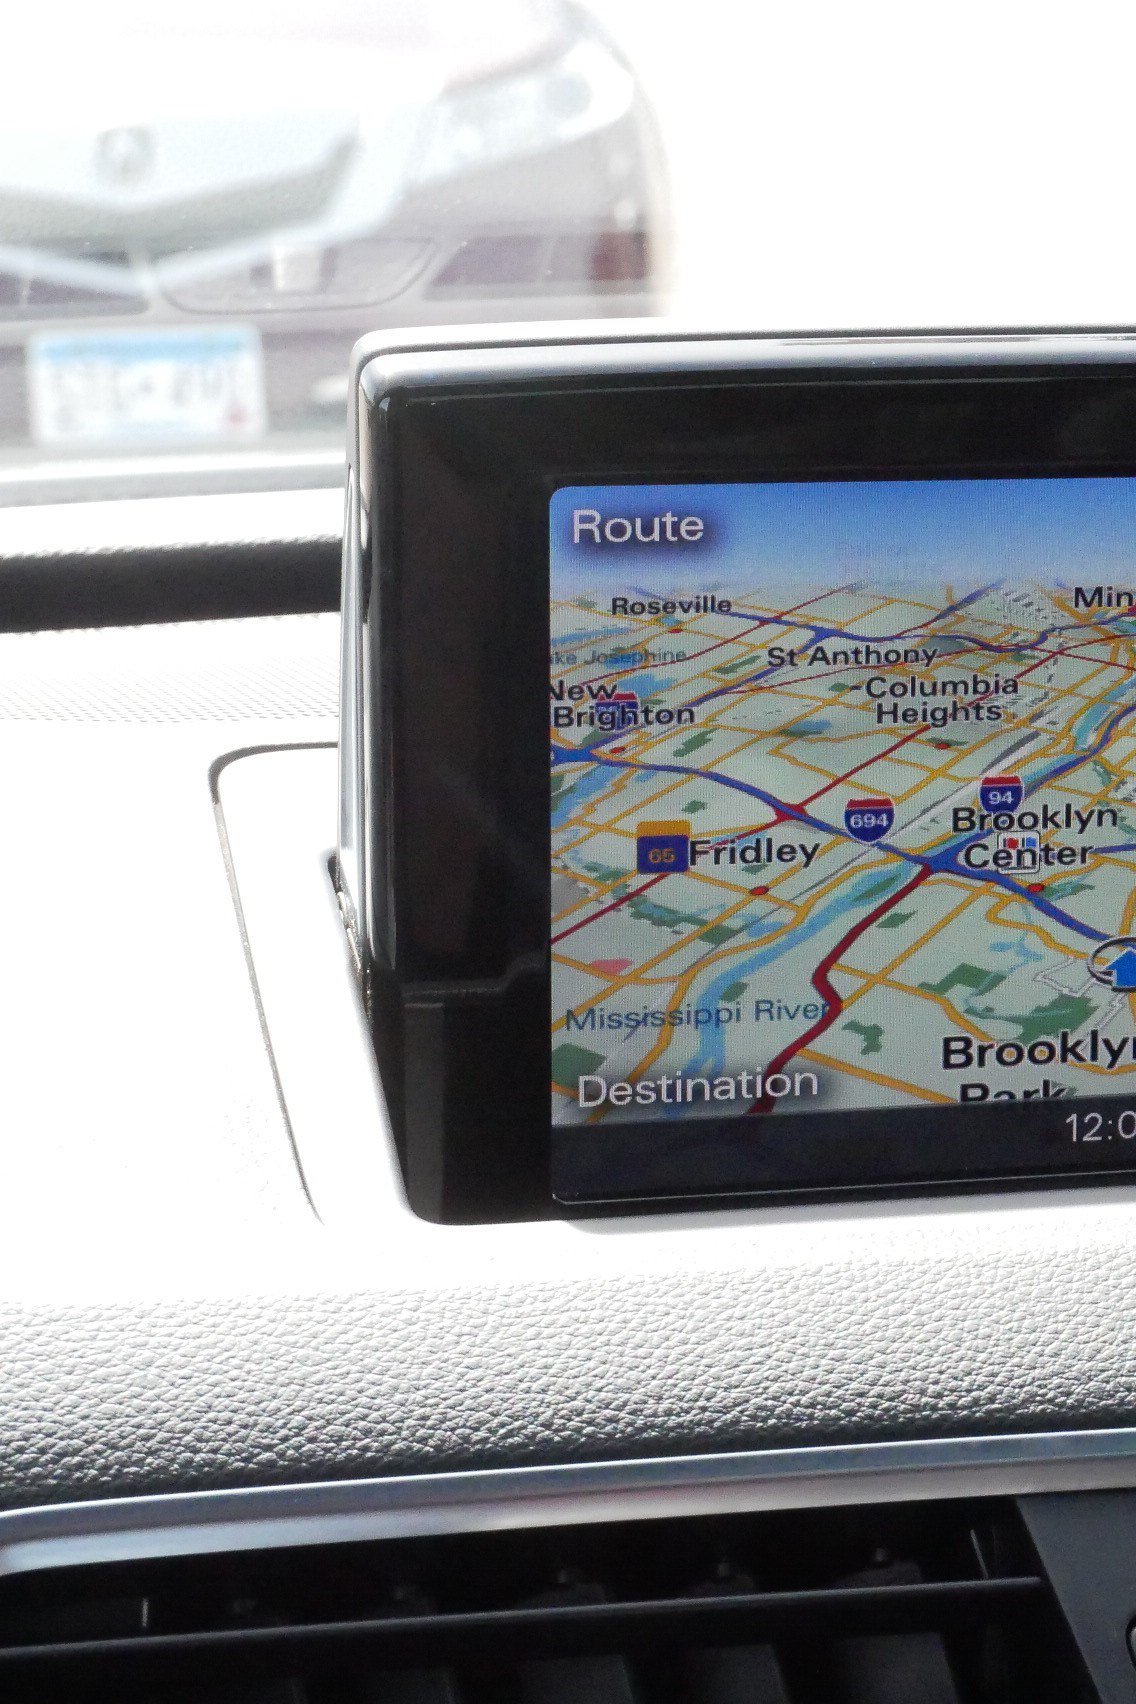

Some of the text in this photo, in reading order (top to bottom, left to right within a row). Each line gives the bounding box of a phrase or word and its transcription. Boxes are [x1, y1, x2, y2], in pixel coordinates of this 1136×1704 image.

[573, 508, 704, 544] Route
[611, 595, 732, 616] Roseville
[768, 646, 938, 667] St Anthony
[548, 680, 617, 701] New
[866, 674, 1018, 698] Columbia
[554, 705, 695, 731] Brighton
[876, 700, 1002, 728] Heights
[988, 791, 1013, 805] 94
[849, 813, 889, 828] 694
[953, 803, 1118, 834] Brooklyn
[689, 837, 820, 868] Fridley
[964, 842, 1094, 869] Center
[566, 1004, 742, 1032] Mississippi
[578, 1067, 819, 1107] Destination
